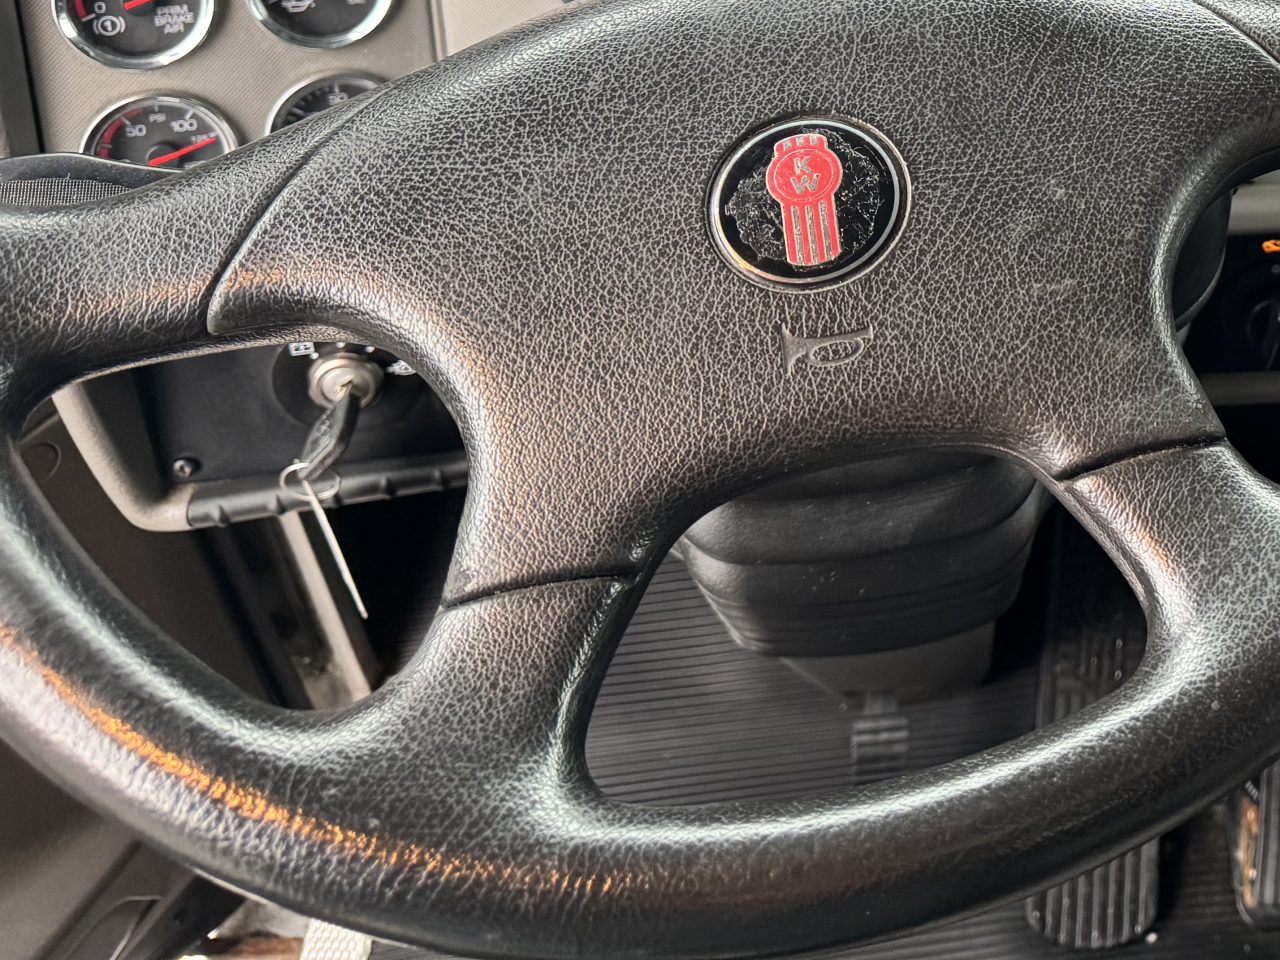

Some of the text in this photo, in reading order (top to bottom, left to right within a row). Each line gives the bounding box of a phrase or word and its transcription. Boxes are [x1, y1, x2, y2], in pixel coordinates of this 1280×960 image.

[94, 1, 106, 14] 0
[126, 124, 147, 137] 50
[170, 118, 198, 133] 100
[793, 156, 811, 174] K
[790, 173, 819, 193] W
